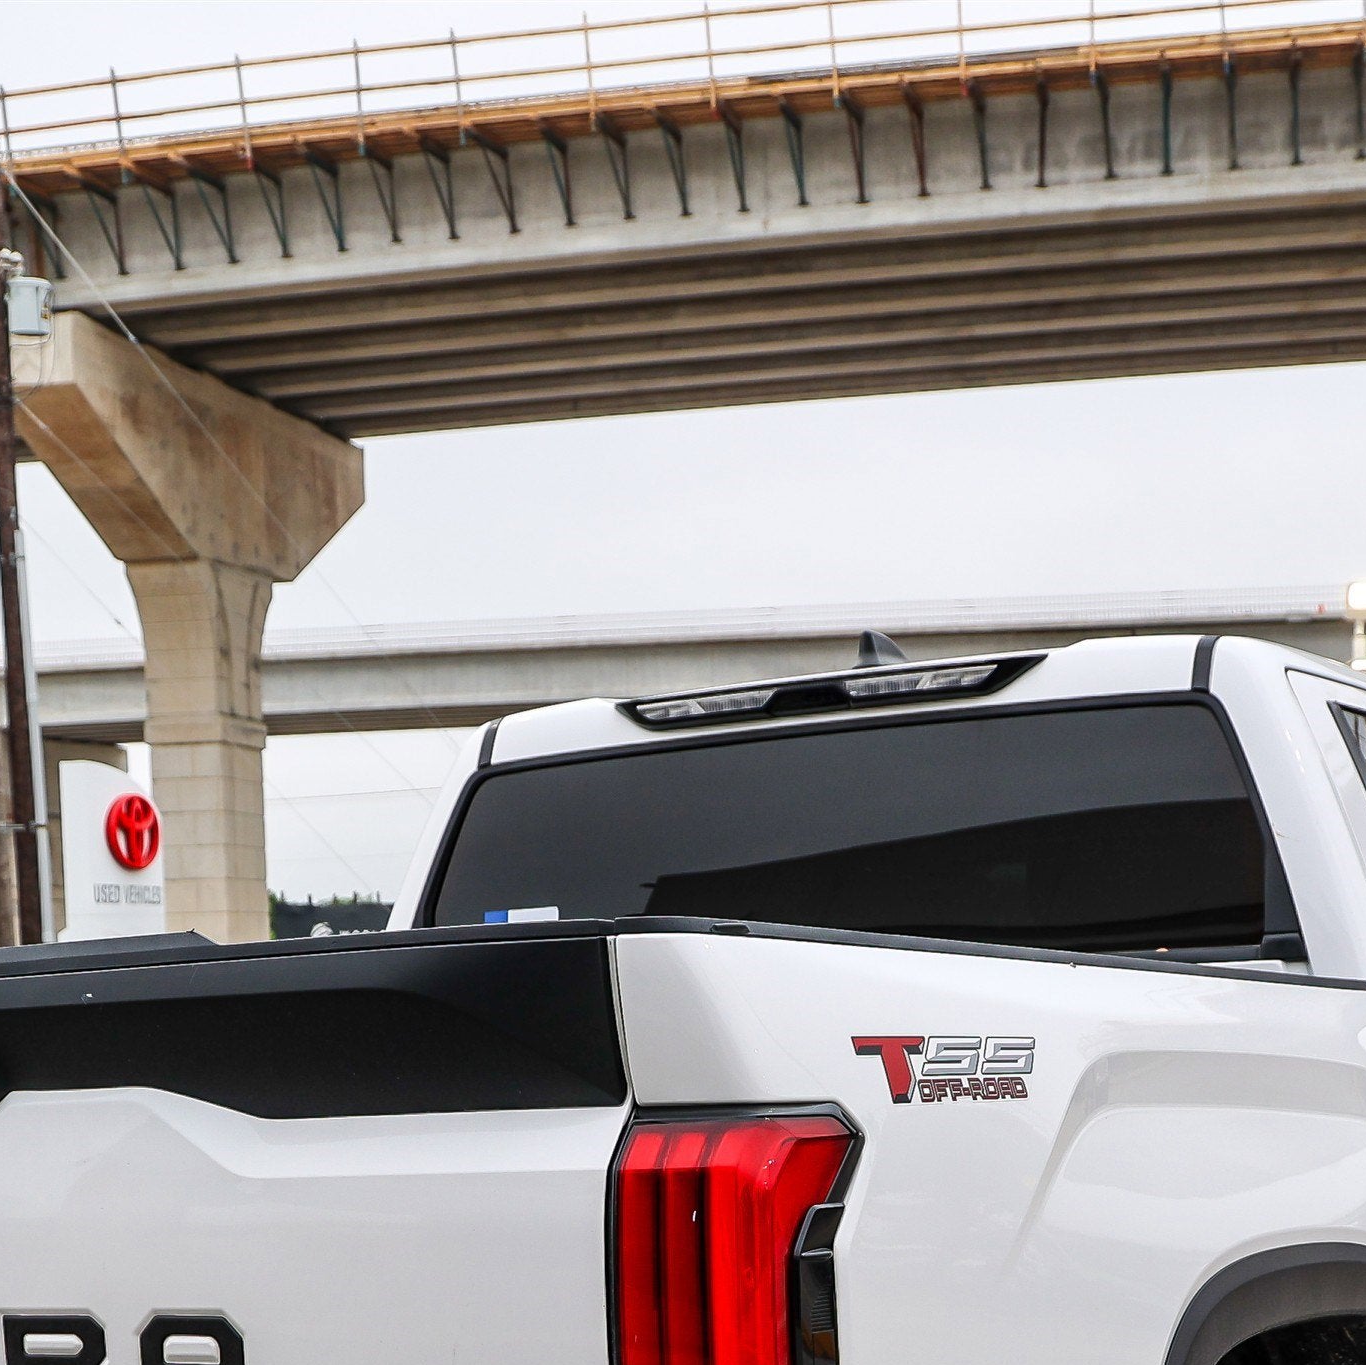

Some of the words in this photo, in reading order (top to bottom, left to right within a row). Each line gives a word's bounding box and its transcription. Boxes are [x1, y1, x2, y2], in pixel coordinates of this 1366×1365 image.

[93, 884, 120, 903] USED
[123, 884, 161, 904] VEHICLES
[917, 1077, 1029, 1102] OFF-ROAD
